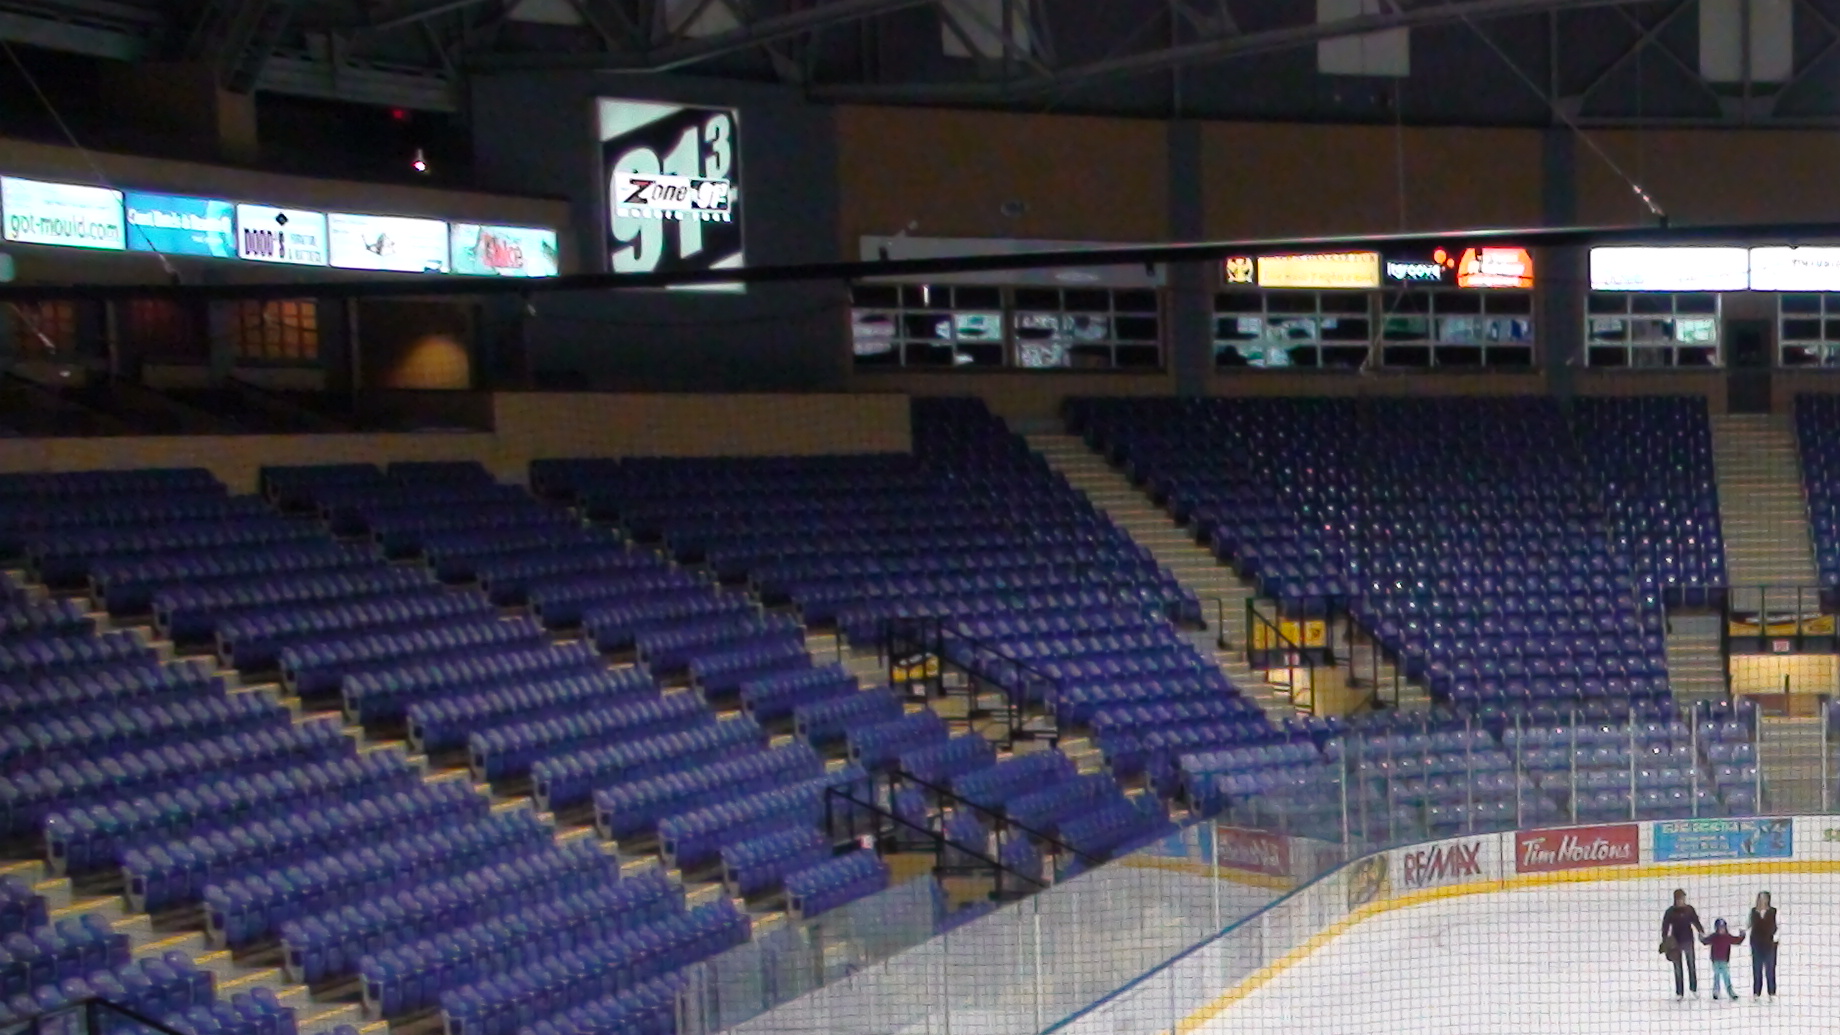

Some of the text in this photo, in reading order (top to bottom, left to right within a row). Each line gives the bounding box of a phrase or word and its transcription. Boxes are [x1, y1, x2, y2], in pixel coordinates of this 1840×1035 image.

[623, 178, 688, 205] Zone
[1403, 841, 1483, 888] RE/MAX
[1521, 835, 1632, 867] Tim Hortons
